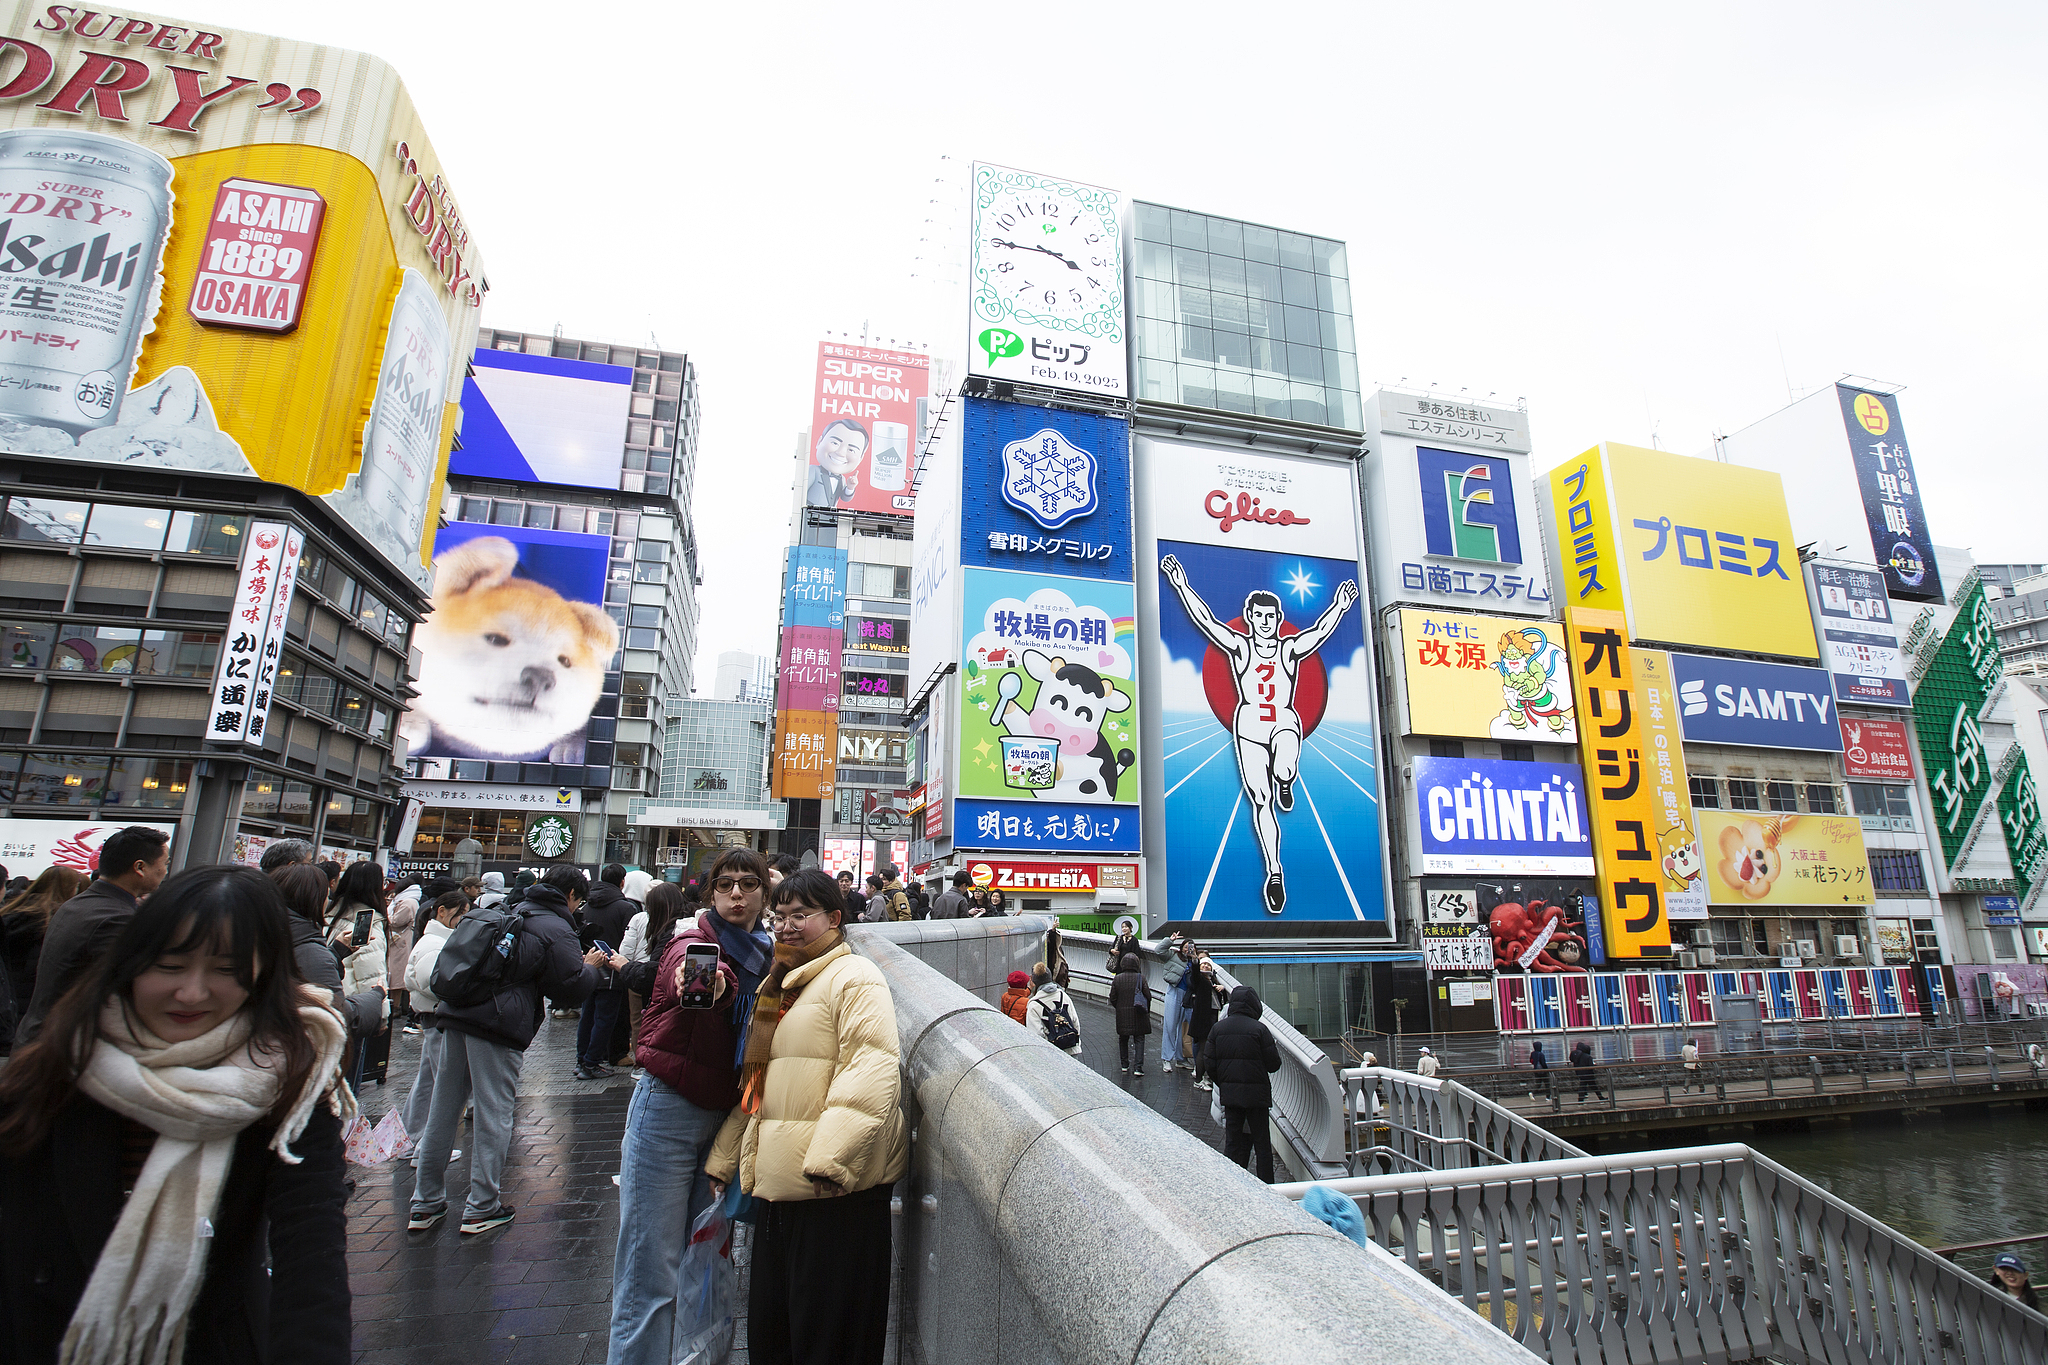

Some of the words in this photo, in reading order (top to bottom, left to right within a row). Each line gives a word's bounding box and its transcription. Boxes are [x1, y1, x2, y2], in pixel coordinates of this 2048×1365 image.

[34, 5, 224, 60] SUPER
[23, 151, 58, 159] KARA
[97, 159, 131, 172] KUCHI
[38, 181, 104, 199] SUPER
[216, 191, 315, 234] ASAHI
[430, 174, 468, 250] SUPER
[1016, 203, 1034, 218] 11
[1040, 202, 1059, 218] 12
[1069, 215, 1079, 225] 1
[996, 213, 1016, 232] 10
[239, 227, 283, 244] since
[1084, 233, 1099, 246] 2
[209, 238, 304, 281] 1889
[997, 261, 1014, 273] 8
[1091, 256, 1107, 267] 3
[1019, 280, 1034, 293] 7
[1086, 275, 1101, 289] 4
[10, 285, 59, 312] 生
[195, 278, 290, 323] OSAKA
[1044, 290, 1056, 304] 6
[1069, 288, 1082, 304] 5
[416, 326, 433, 354] SUPER
[1031, 337, 1091, 365] ピップ
[824, 359, 902, 384] SUPER
[1031, 366, 1059, 380] Feb.
[1083, 373, 1119, 389] 2025
[386, 352, 437, 441] Asahi
[822, 378, 909, 403] MILLION
[821, 397, 881, 418] HAIR
[1417, 400, 1492, 422] 夢ある住まい
[1862, 395, 1884, 431] 占
[400, 416, 414, 447] 生
[1407, 417, 1507, 444] エステムシリーズ
[882, 455, 898, 463] SMH
[1868, 440, 1912, 538] 千里眼
[1204, 489, 1311, 533] Glico
[1563, 463, 1607, 599] プロミス
[987, 531, 1113, 560] 雪印メグミルク
[1633, 515, 1790, 581] プロミス
[796, 566, 837, 584] 龍角散
[915, 539, 947, 624] FANCL
[1401, 562, 1549, 601] 日商エステム
[241, 554, 271, 625] 本場の味
[273, 562, 292, 631] 本場の味
[789, 584, 843, 602] ダイレクト
[1033, 604, 1070, 613] まきばのあさ
[857, 620, 894, 639] 焼肉
[993, 610, 1107, 646] 牧場の朝
[1422, 619, 1479, 639] かぜに
[869, 643, 899, 652] Wagyu
[1014, 639, 1040, 648] Makiba
[1053, 642, 1066, 650] Asa
[1068, 643, 1089, 653] Yogurt
[1416, 639, 1490, 671] 改源
[1834, 645, 1857, 659] AGA
[1871, 649, 1895, 662] スキン
[791, 647, 831, 666] 龍角散
[783, 666, 838, 684] ダイレクト
[1849, 661, 1887, 675] クリニック
[858, 677, 888, 693] 力丸
[1254, 660, 1277, 722] グリコ
[1851, 686, 1892, 697] ここから徒歩5分
[1714, 684, 1830, 724] SAMTY
[785, 732, 827, 751] 龍角散
[778, 752, 833, 771] ダイレクト
[1010, 749, 1050, 760] 牧場の朝
[701, 771, 721, 779] なんば
[1427, 771, 1582, 842] CHINTAI
[1790, 849, 1828, 862] 大阪土産
[401, 862, 449, 871] RBUCKS
[1794, 868, 1811, 879] 大阪
[1811, 865, 1866, 884] 花ラング
[997, 868, 1092, 888] ZETTERIA
[1437, 893, 1469, 918] くくる
[1667, 897, 1701, 905] www.jsv.jp
[1428, 943, 1483, 964] 大阪に乾杯
